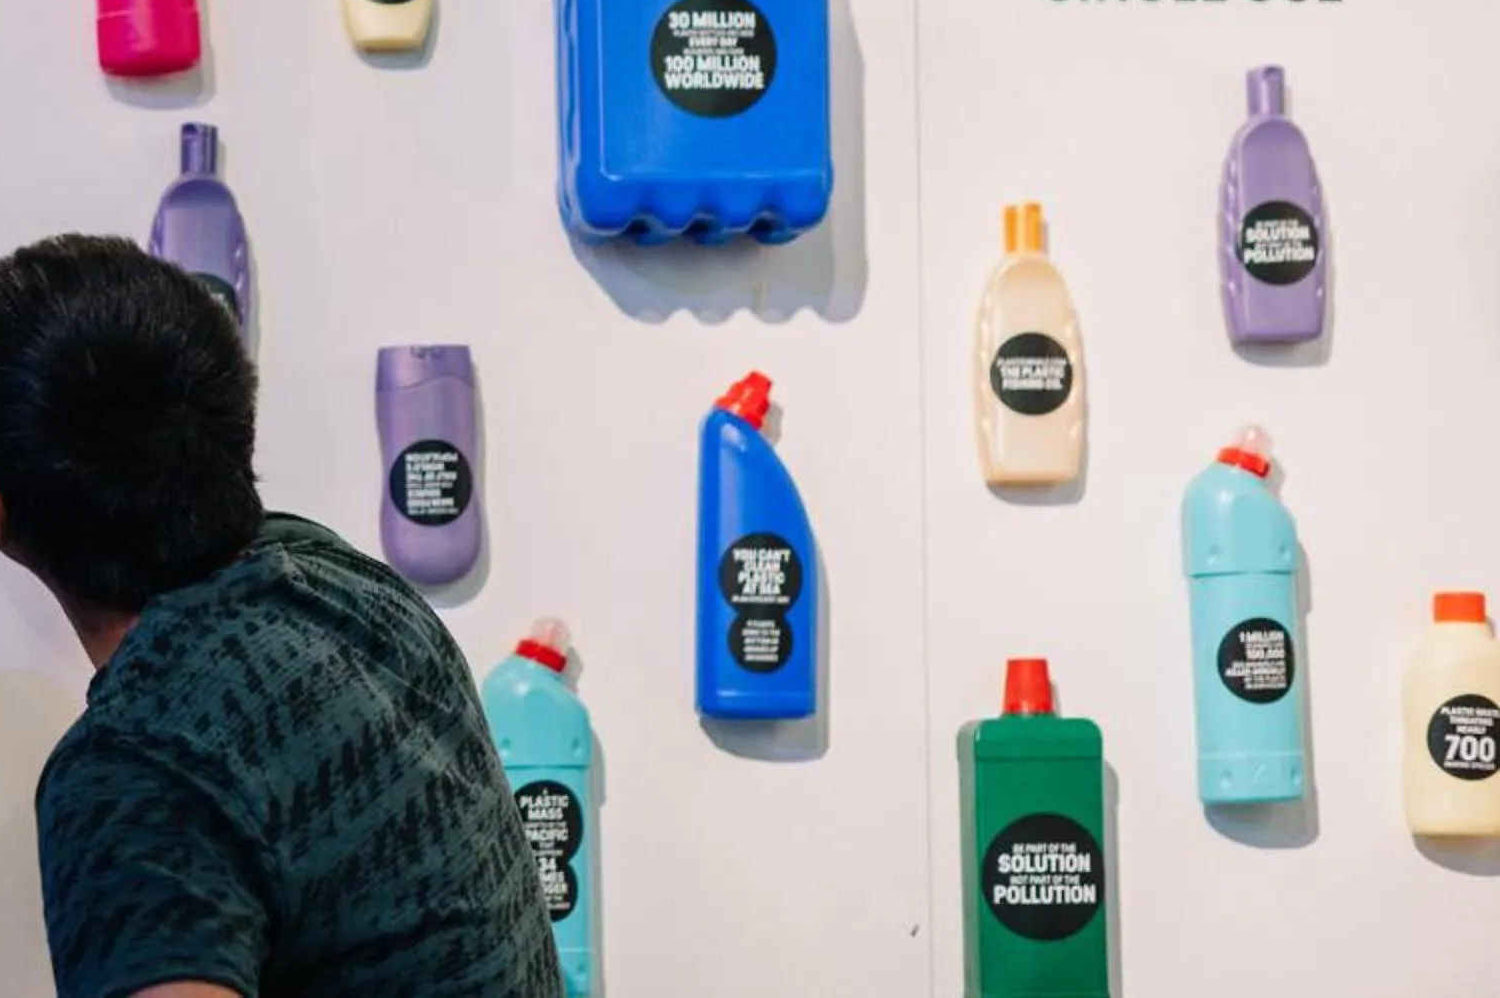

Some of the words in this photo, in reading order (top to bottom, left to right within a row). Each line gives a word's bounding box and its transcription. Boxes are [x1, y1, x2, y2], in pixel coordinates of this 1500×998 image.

[668, 12, 691, 30] 30
[693, 12, 757, 30] MILLION
[689, 37, 715, 48] EVERY
[717, 37, 738, 48] DAY
[665, 55, 695, 72] 100
[697, 55, 761, 73] MILLION
[665, 72, 765, 90] WORLDWIDE
[1246, 226, 1309, 242] SOLUTION
[1244, 247, 1314, 263] POLLUTION
[733, 549, 758, 562] YOU
[738, 571, 785, 584] PLASTIC
[1444, 735, 1496, 762] 700
[520, 795, 569, 809] PLASTIC
[527, 807, 564, 821] MASS
[525, 828, 569, 842] PACIFIC
[1028, 844, 1047, 854] PART
[1048, 844, 1060, 854] OF
[1061, 844, 1077, 854] THE
[538, 857, 557, 871] 34
[998, 854, 1092, 873] SOLUTION
[1030, 874, 1049, 884] PART
[1051, 874, 1062, 884] OF
[1063, 874, 1080, 884] THE
[993, 884, 1098, 905] POLLUTION
